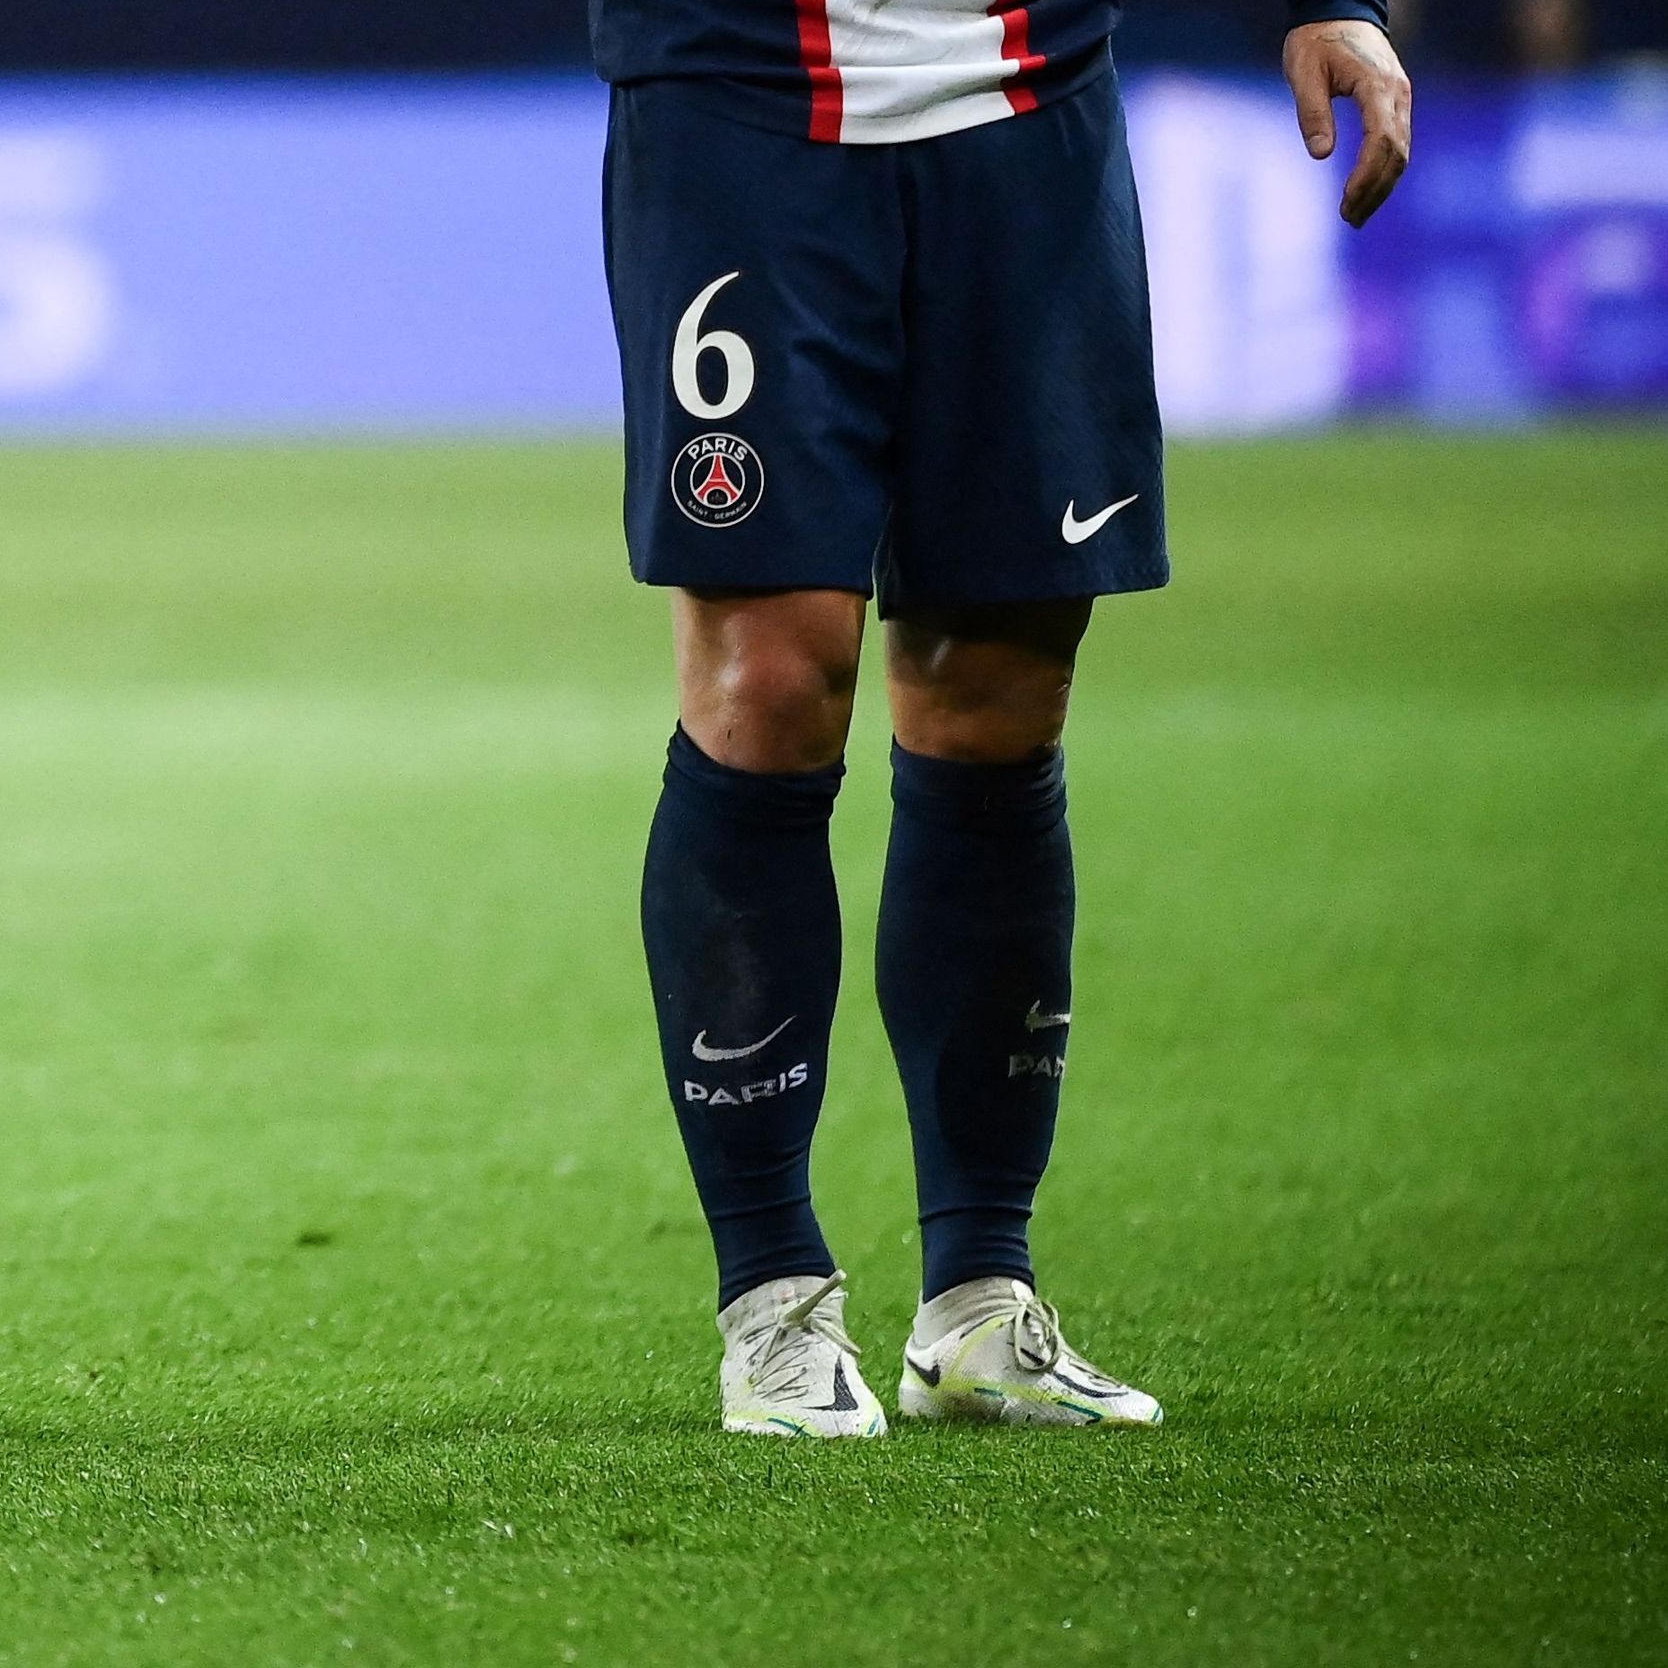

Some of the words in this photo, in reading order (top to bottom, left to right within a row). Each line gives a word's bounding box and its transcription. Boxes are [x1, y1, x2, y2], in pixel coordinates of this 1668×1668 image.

[672, 271, 755, 419] 6
[687, 438, 748, 461] PARIS
[684, 1062, 808, 1105] PARIS
